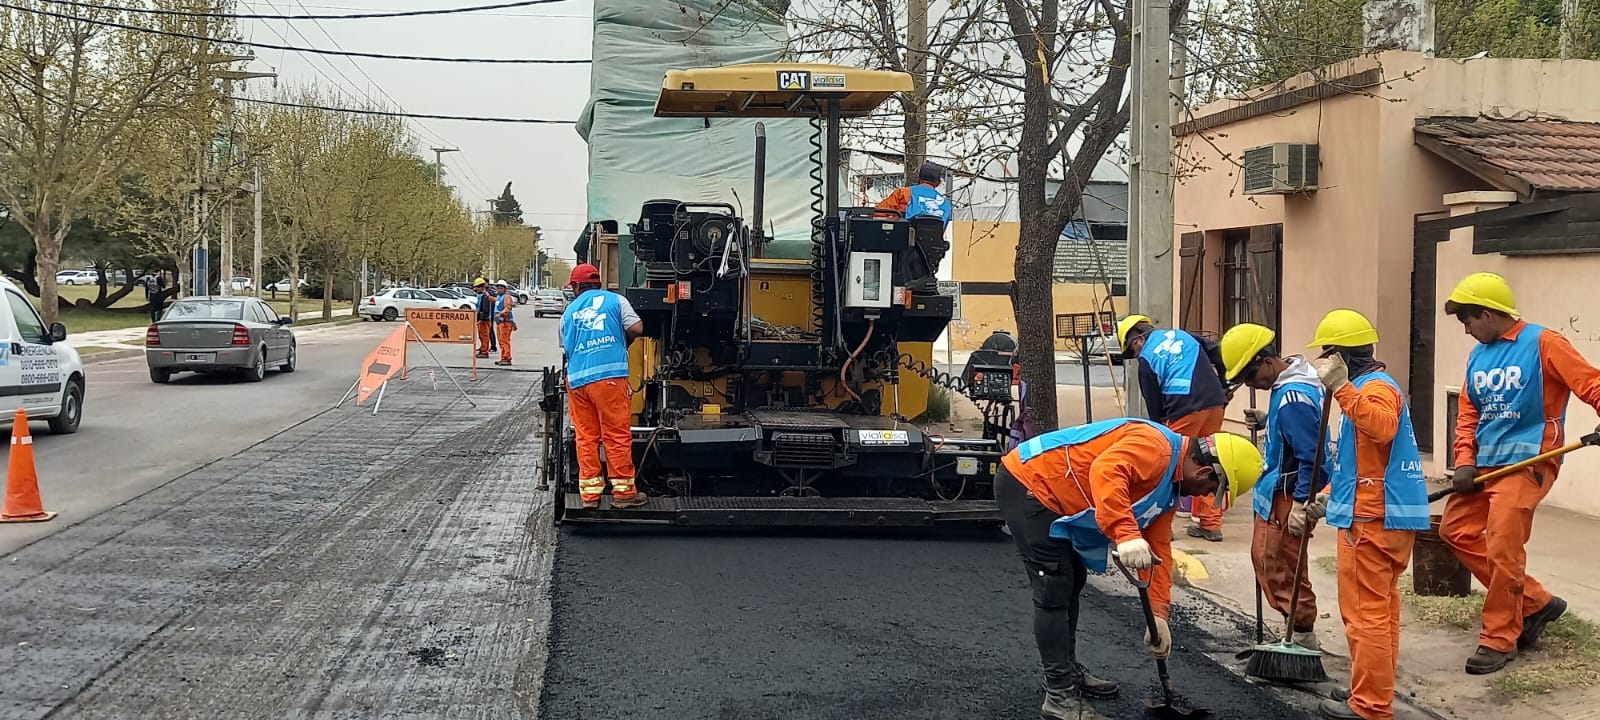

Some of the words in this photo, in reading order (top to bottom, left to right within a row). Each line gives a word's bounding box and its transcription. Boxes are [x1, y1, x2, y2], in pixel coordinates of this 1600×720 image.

[780, 72, 807, 89] CAT
[410, 311, 434, 320] CALLE
[435, 312, 470, 321] CERRADA
[586, 335, 616, 349] PAMPA
[1473, 365, 1523, 395] POR
[1493, 394, 1505, 402] DE
